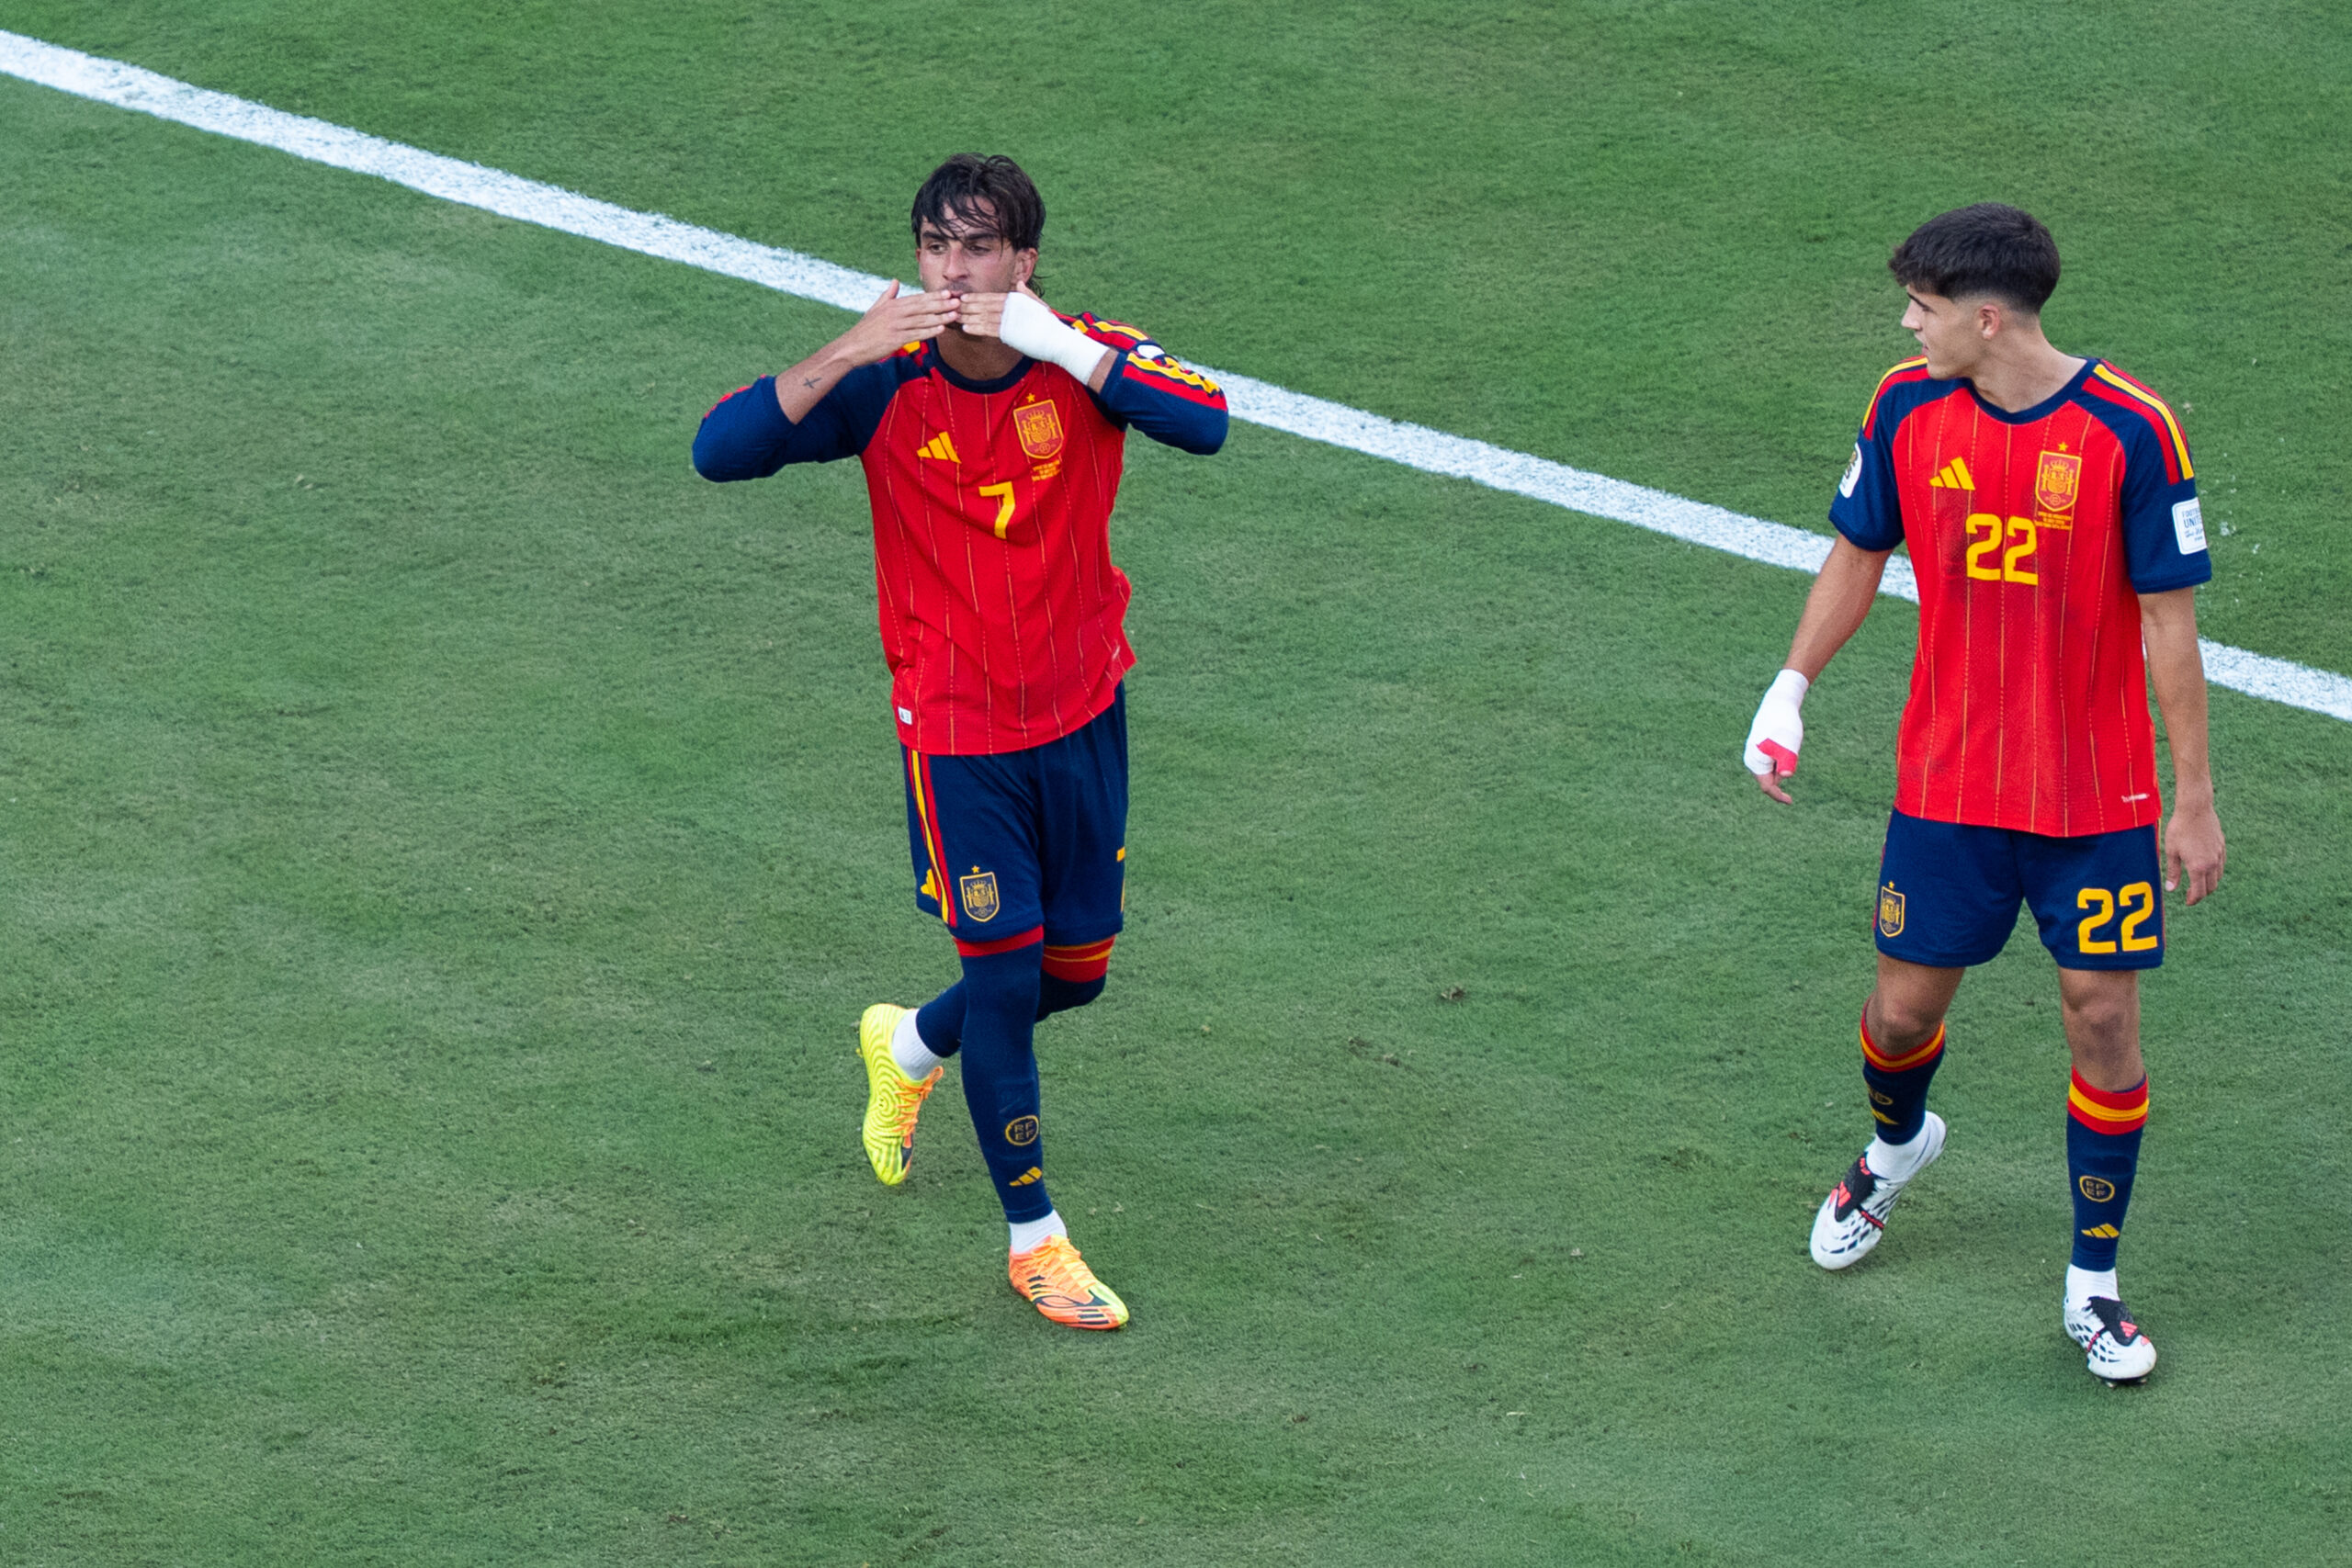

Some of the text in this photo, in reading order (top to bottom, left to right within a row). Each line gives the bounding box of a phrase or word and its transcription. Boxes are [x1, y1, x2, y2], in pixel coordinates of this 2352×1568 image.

[978, 480, 1015, 539] 7
[2181, 507, 2201, 518] FOOTB
[2183, 515, 2203, 529] UNITE
[1965, 513, 2039, 586] 22
[2077, 881, 2158, 954] 22
